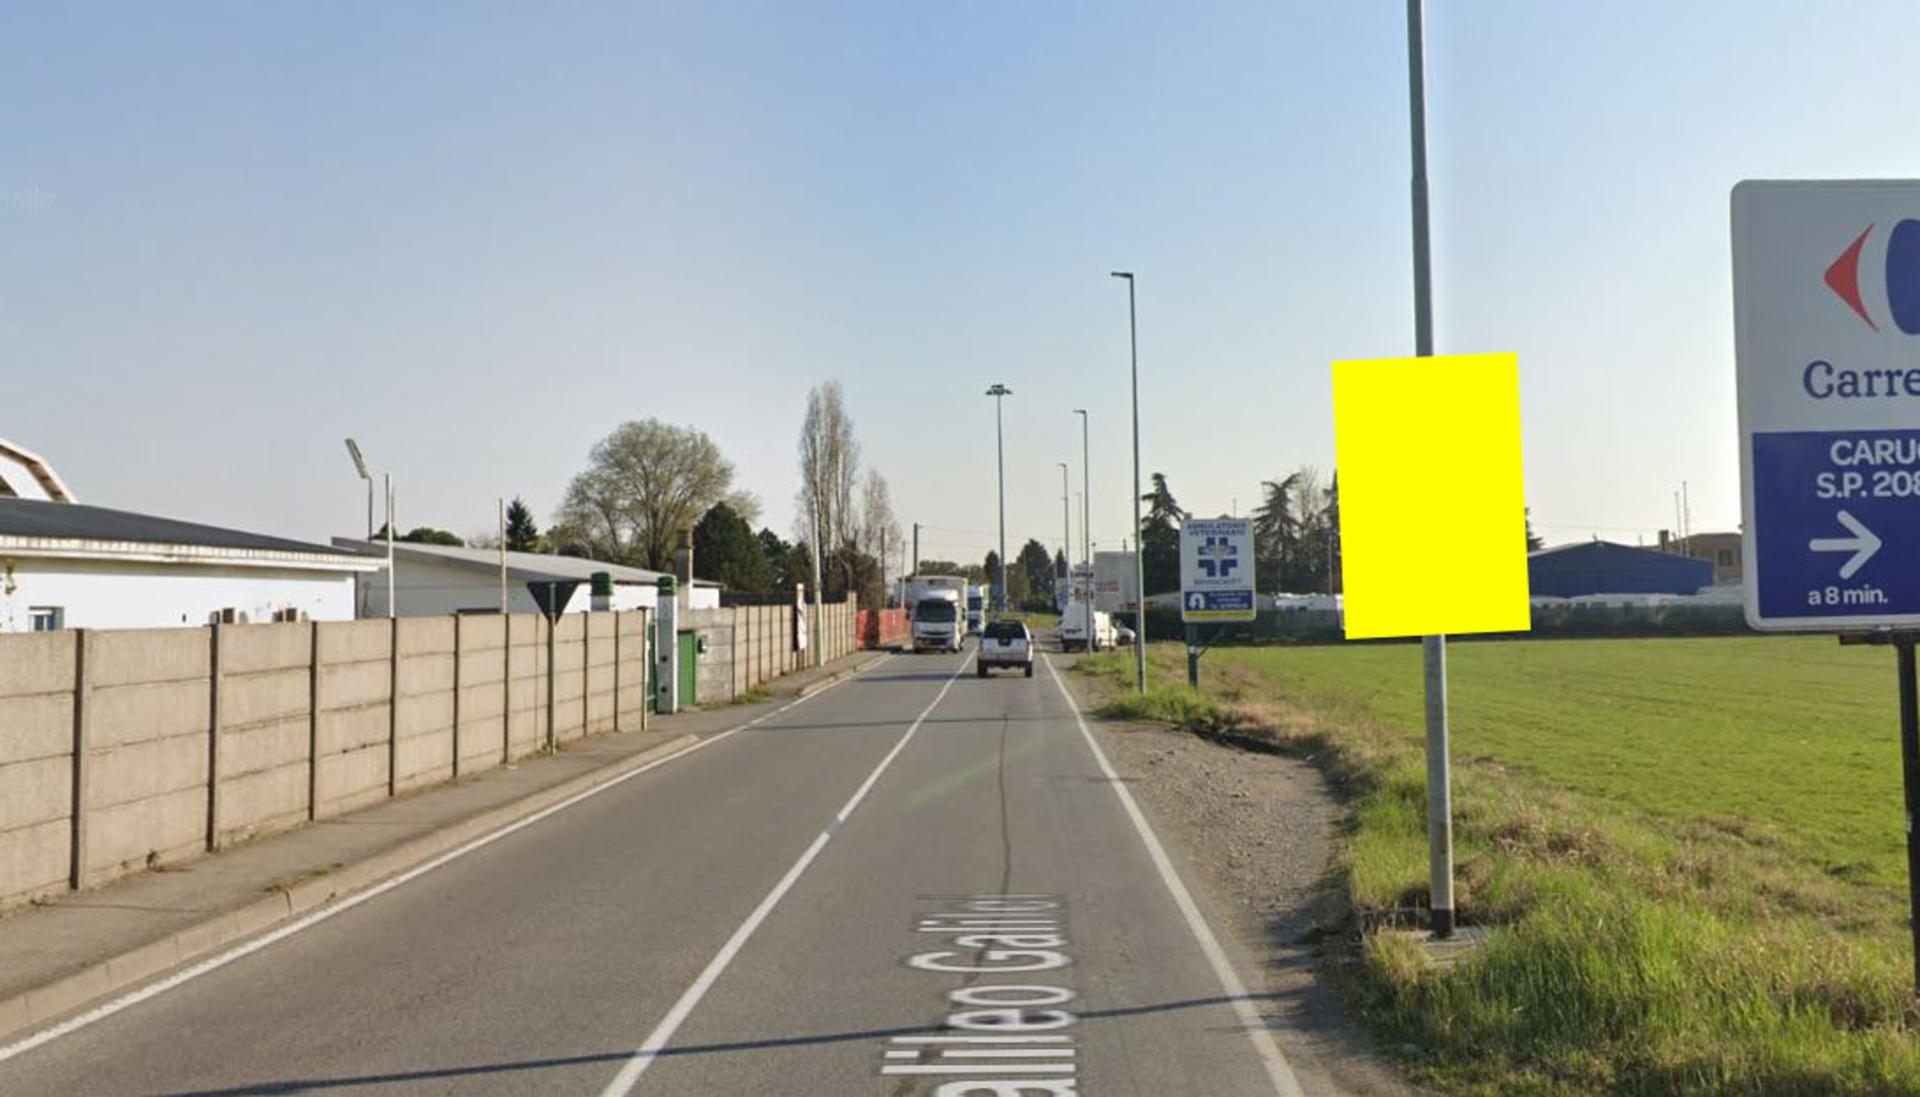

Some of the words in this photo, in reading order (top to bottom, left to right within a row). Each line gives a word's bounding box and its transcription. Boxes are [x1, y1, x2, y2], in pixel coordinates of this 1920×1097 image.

[1803, 360, 1920, 399] Carre
[1830, 439, 1920, 466] CARU
[1816, 473, 1867, 498] S.P.
[1808, 589, 1821, 605] a
[1825, 586, 1839, 604] 8
[1843, 585, 1888, 603] min.
